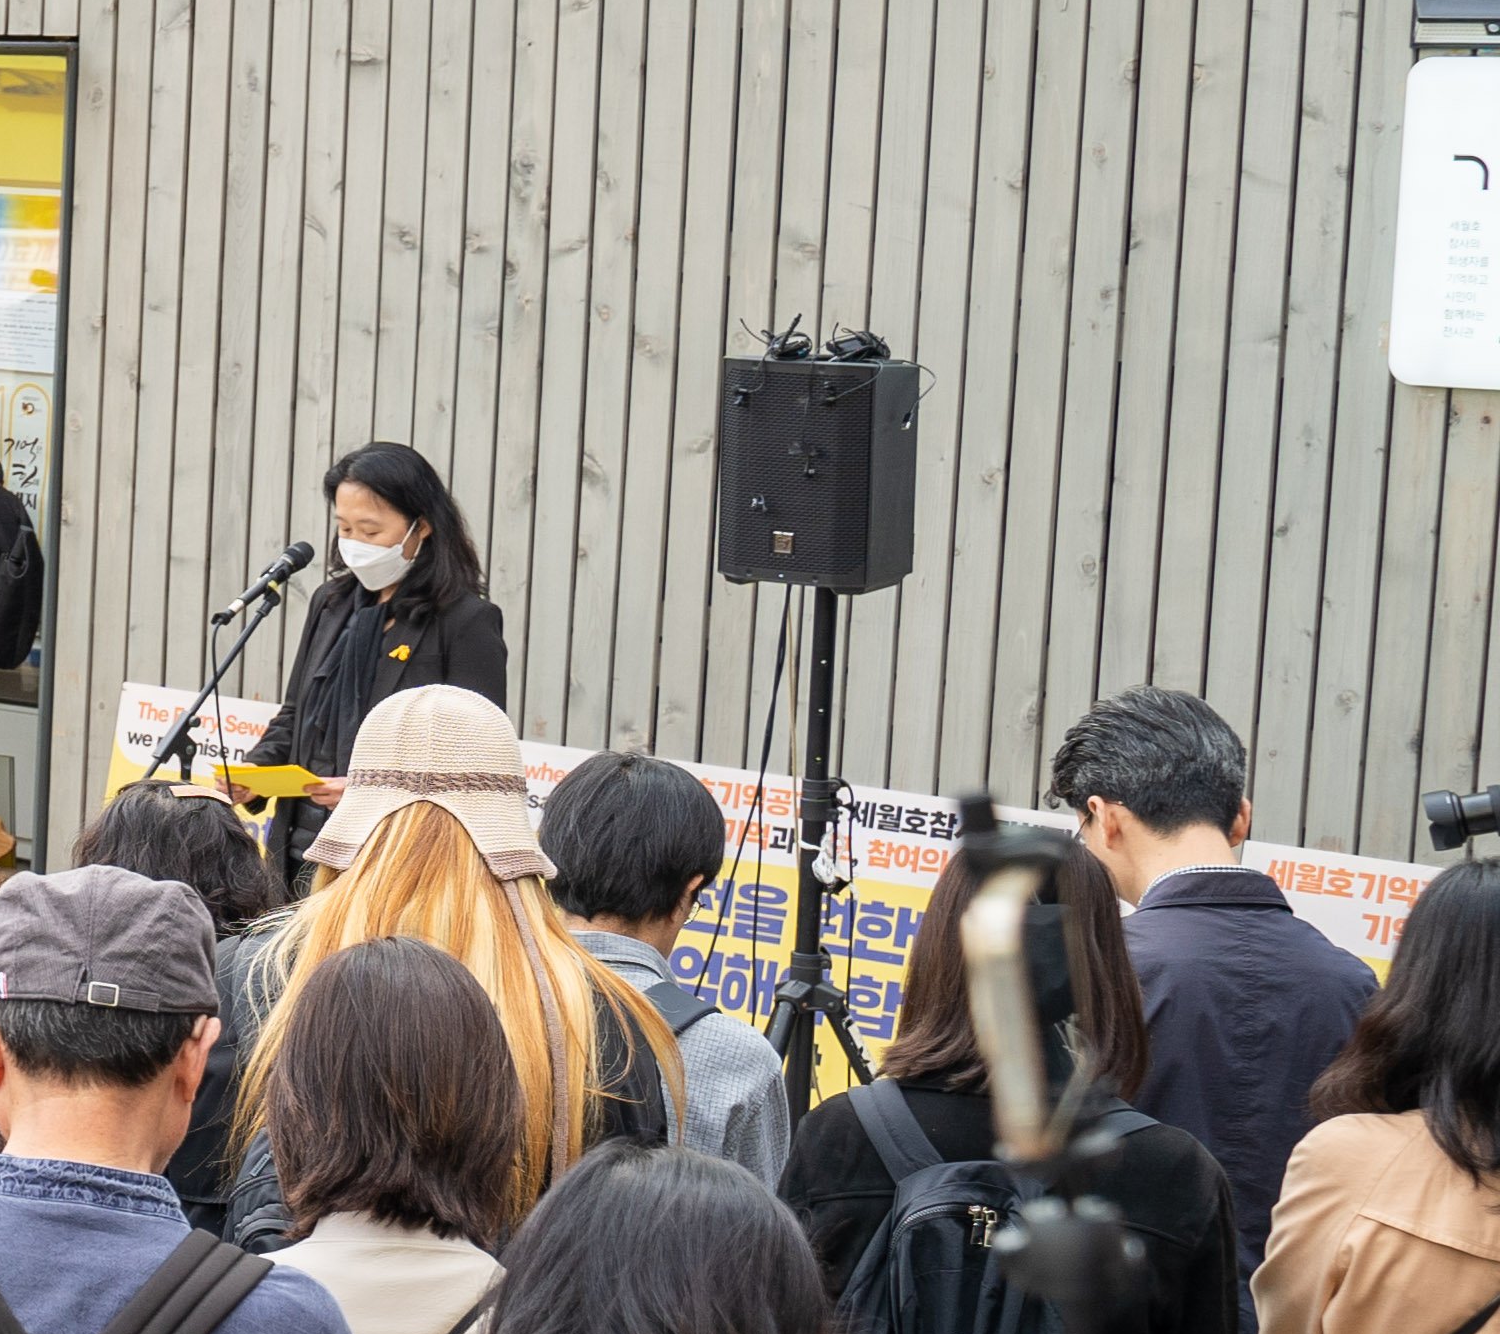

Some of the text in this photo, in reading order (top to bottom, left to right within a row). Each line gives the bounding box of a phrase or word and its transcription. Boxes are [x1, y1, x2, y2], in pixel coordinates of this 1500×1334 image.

[138, 701, 269, 737] The Frry Sew
[127, 731, 153, 747] we
[524, 762, 570, 785] whe
[853, 801, 964, 841] 세월호참
[1265, 859, 1433, 908] 세월호기억
